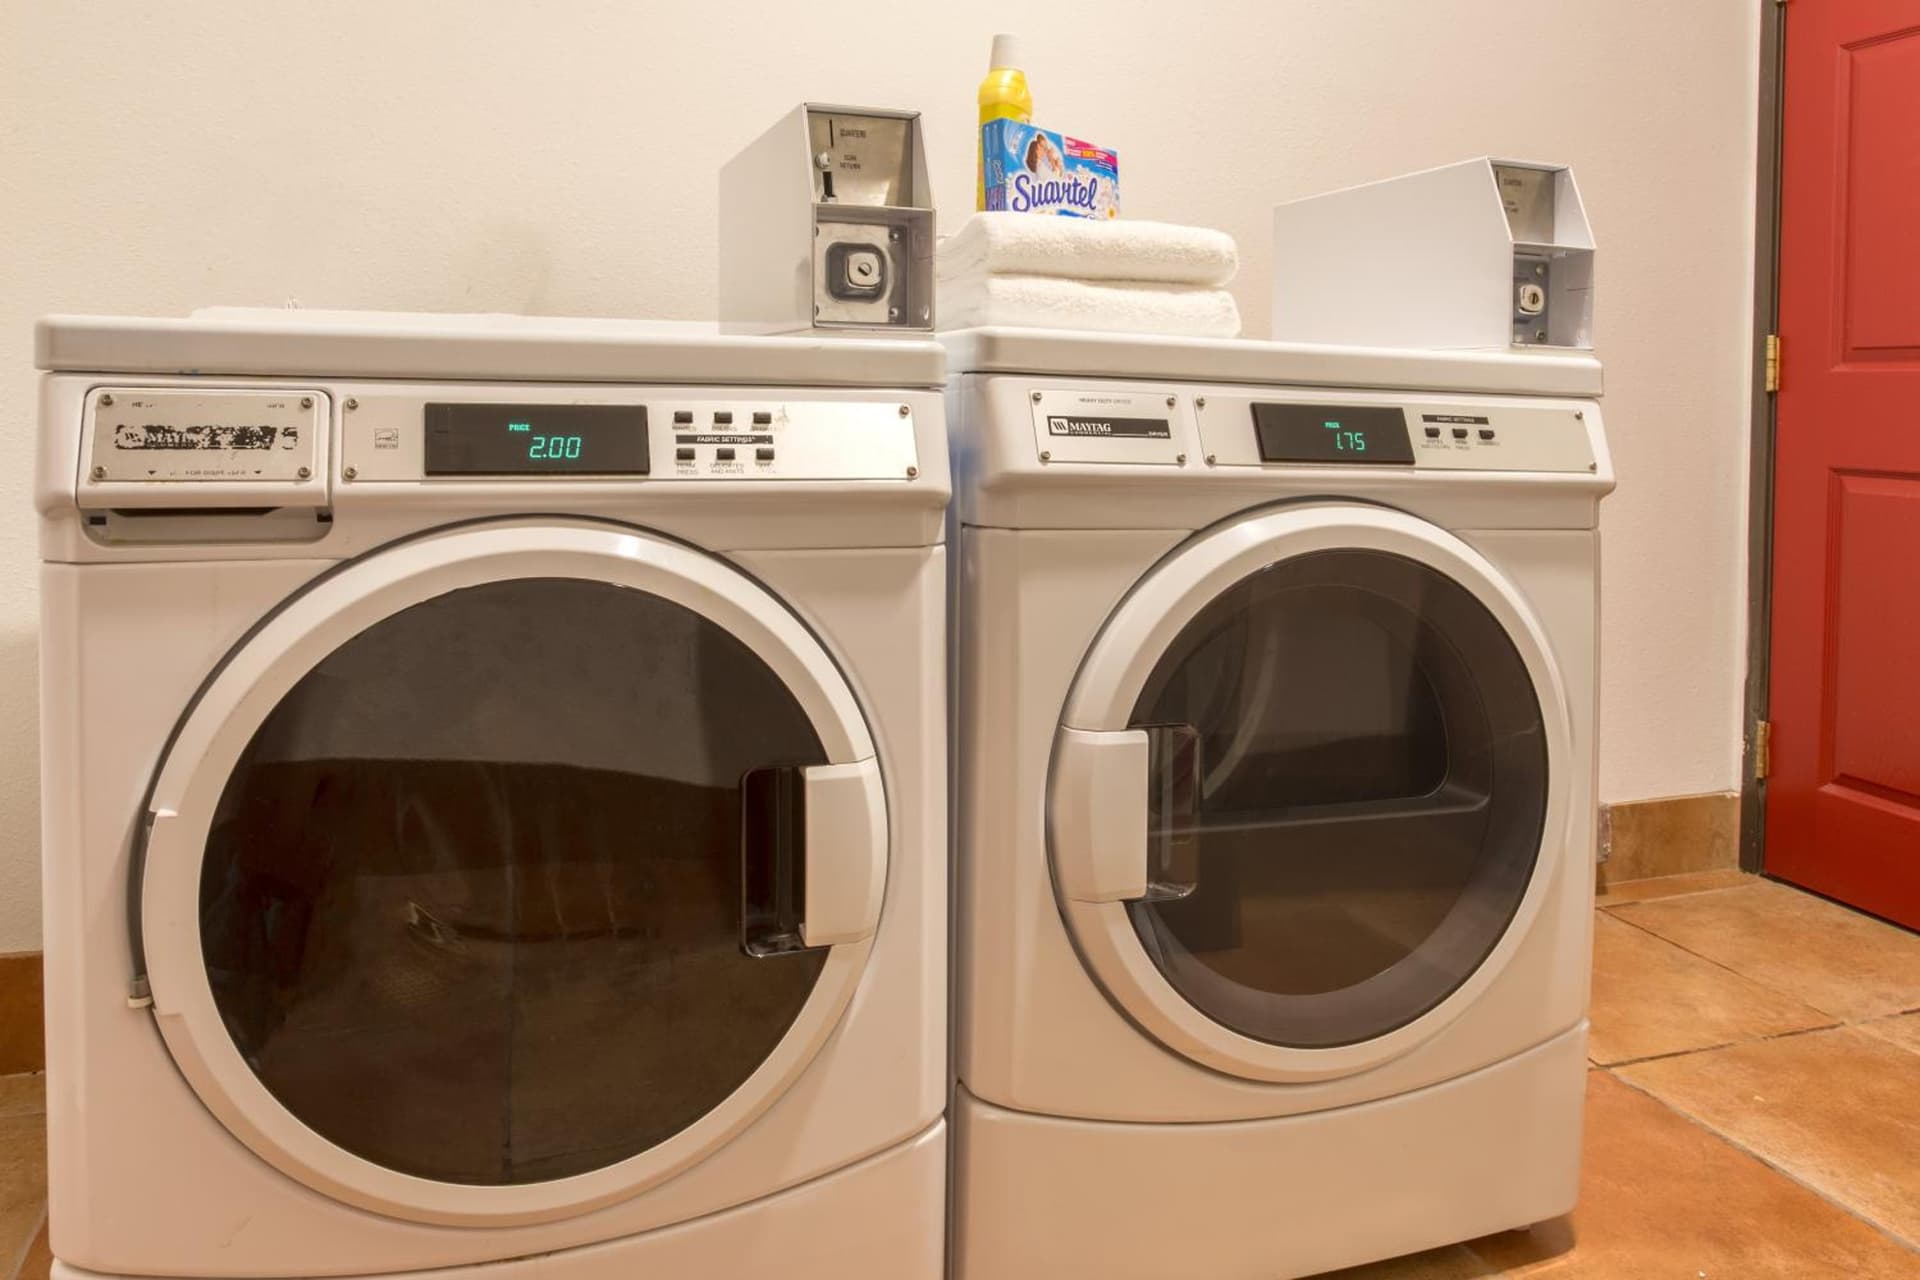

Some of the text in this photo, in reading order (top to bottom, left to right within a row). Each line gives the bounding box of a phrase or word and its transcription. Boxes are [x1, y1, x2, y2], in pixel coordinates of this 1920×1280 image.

[1012, 174, 1097, 212] Suavitel
[1069, 422, 1112, 432] MAYTAG
[529, 436, 581, 458] 2.00
[1336, 432, 1366, 451] 1.75
